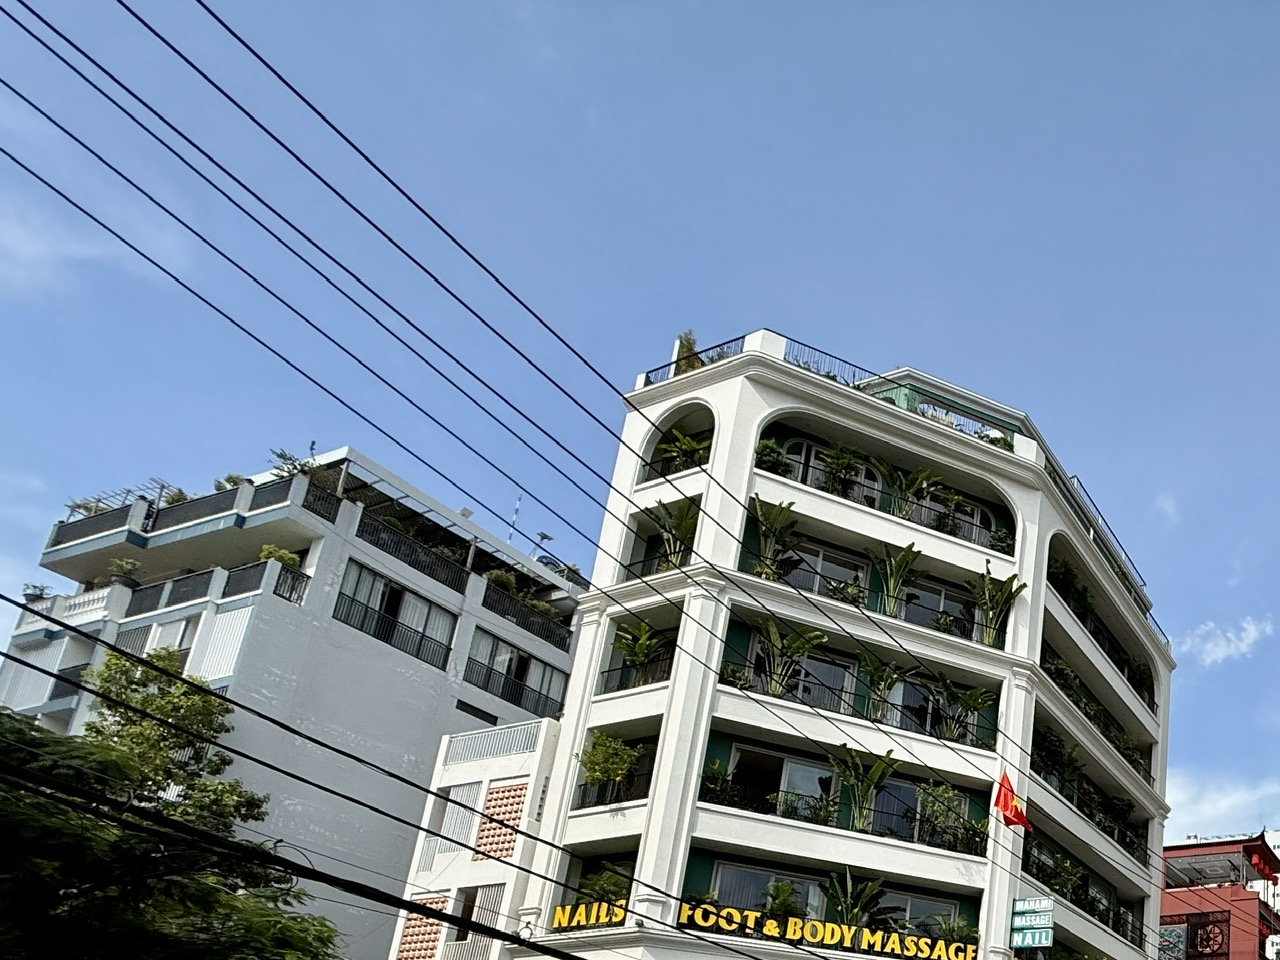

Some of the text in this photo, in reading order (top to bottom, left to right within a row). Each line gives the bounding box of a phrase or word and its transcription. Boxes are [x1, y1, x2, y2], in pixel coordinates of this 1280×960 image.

[1015, 899, 1052, 911] MAHAMI
[552, 899, 627, 929] NAILS
[678, 902, 762, 934] FOOT
[762, 918, 781, 938] &
[785, 917, 858, 948] BODY
[1014, 915, 1050, 927] MASSAGE
[1013, 932, 1048, 945] NAIL
